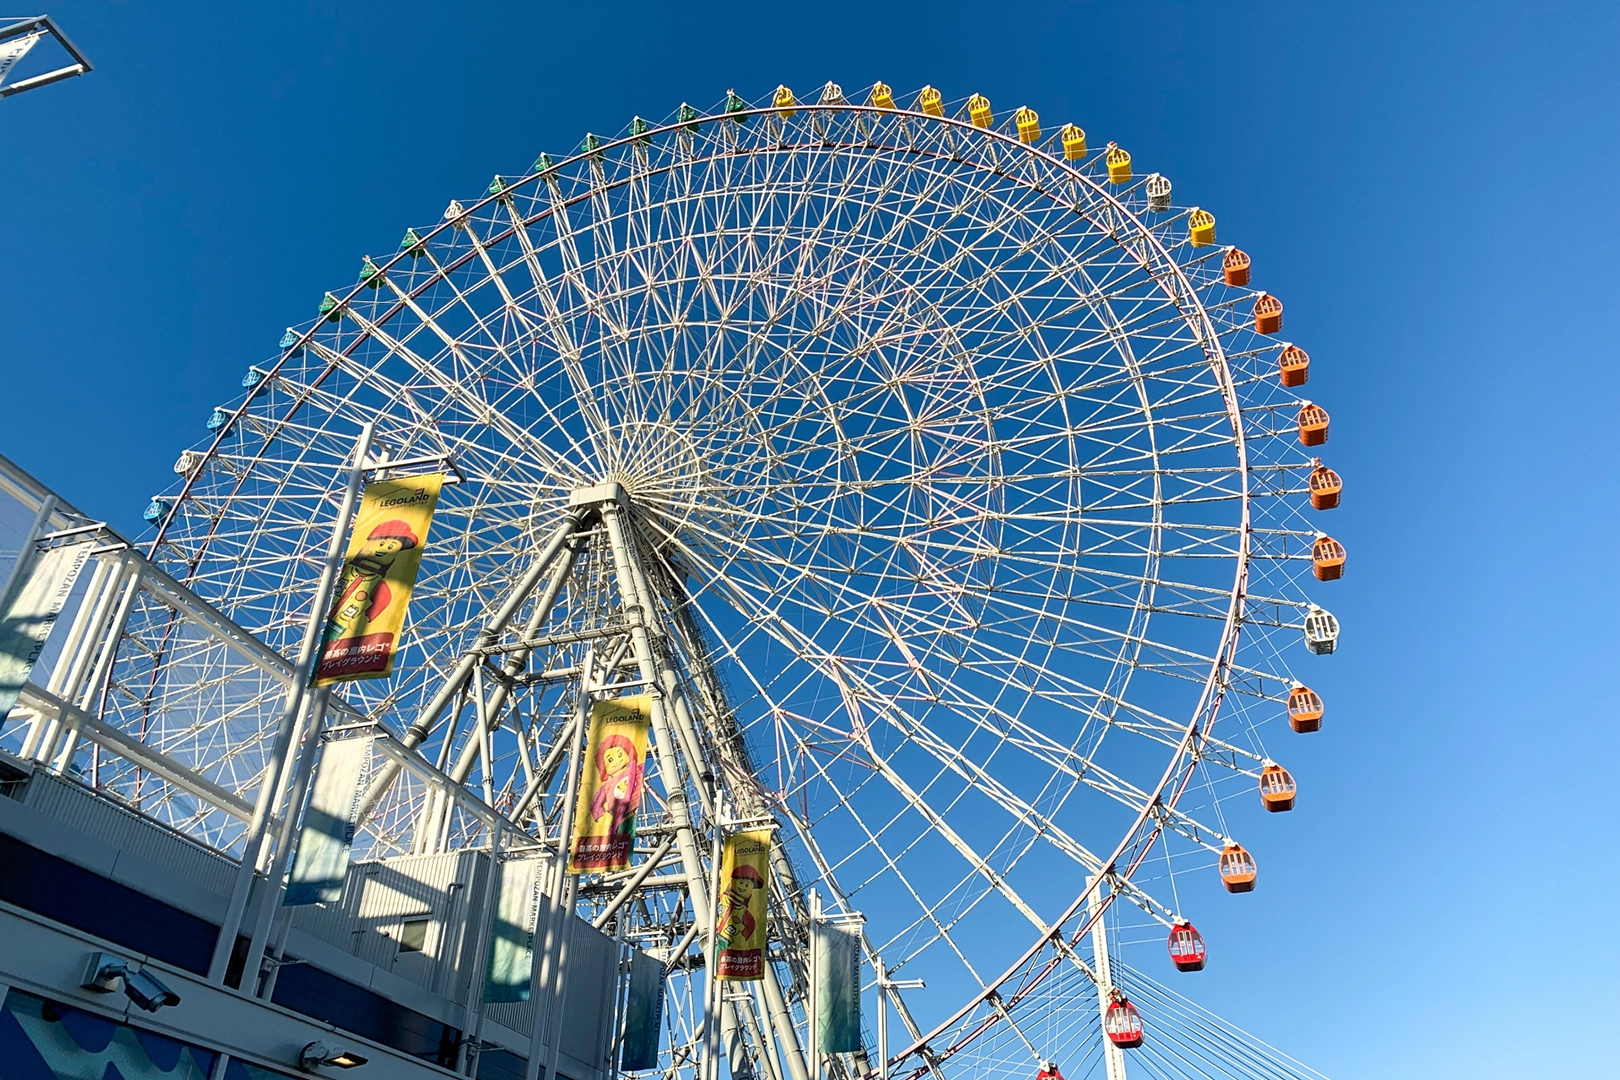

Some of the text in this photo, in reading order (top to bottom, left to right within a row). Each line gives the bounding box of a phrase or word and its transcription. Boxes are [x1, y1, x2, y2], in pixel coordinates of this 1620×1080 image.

[380, 493, 430, 507] LEGOLAND
[19, 544, 92, 678] TEMPOZAN MARKETPLACE
[322, 655, 381, 671] プレイグラウンド
[606, 714, 644, 723] LEGOLAND
[341, 739, 374, 854] TEMPOZAN MARKETPLACE
[525, 860, 543, 960] TEMPOZAN MARKETPLACE
[852, 927, 861, 1015] TEMPOZAN MARKETPLACE
